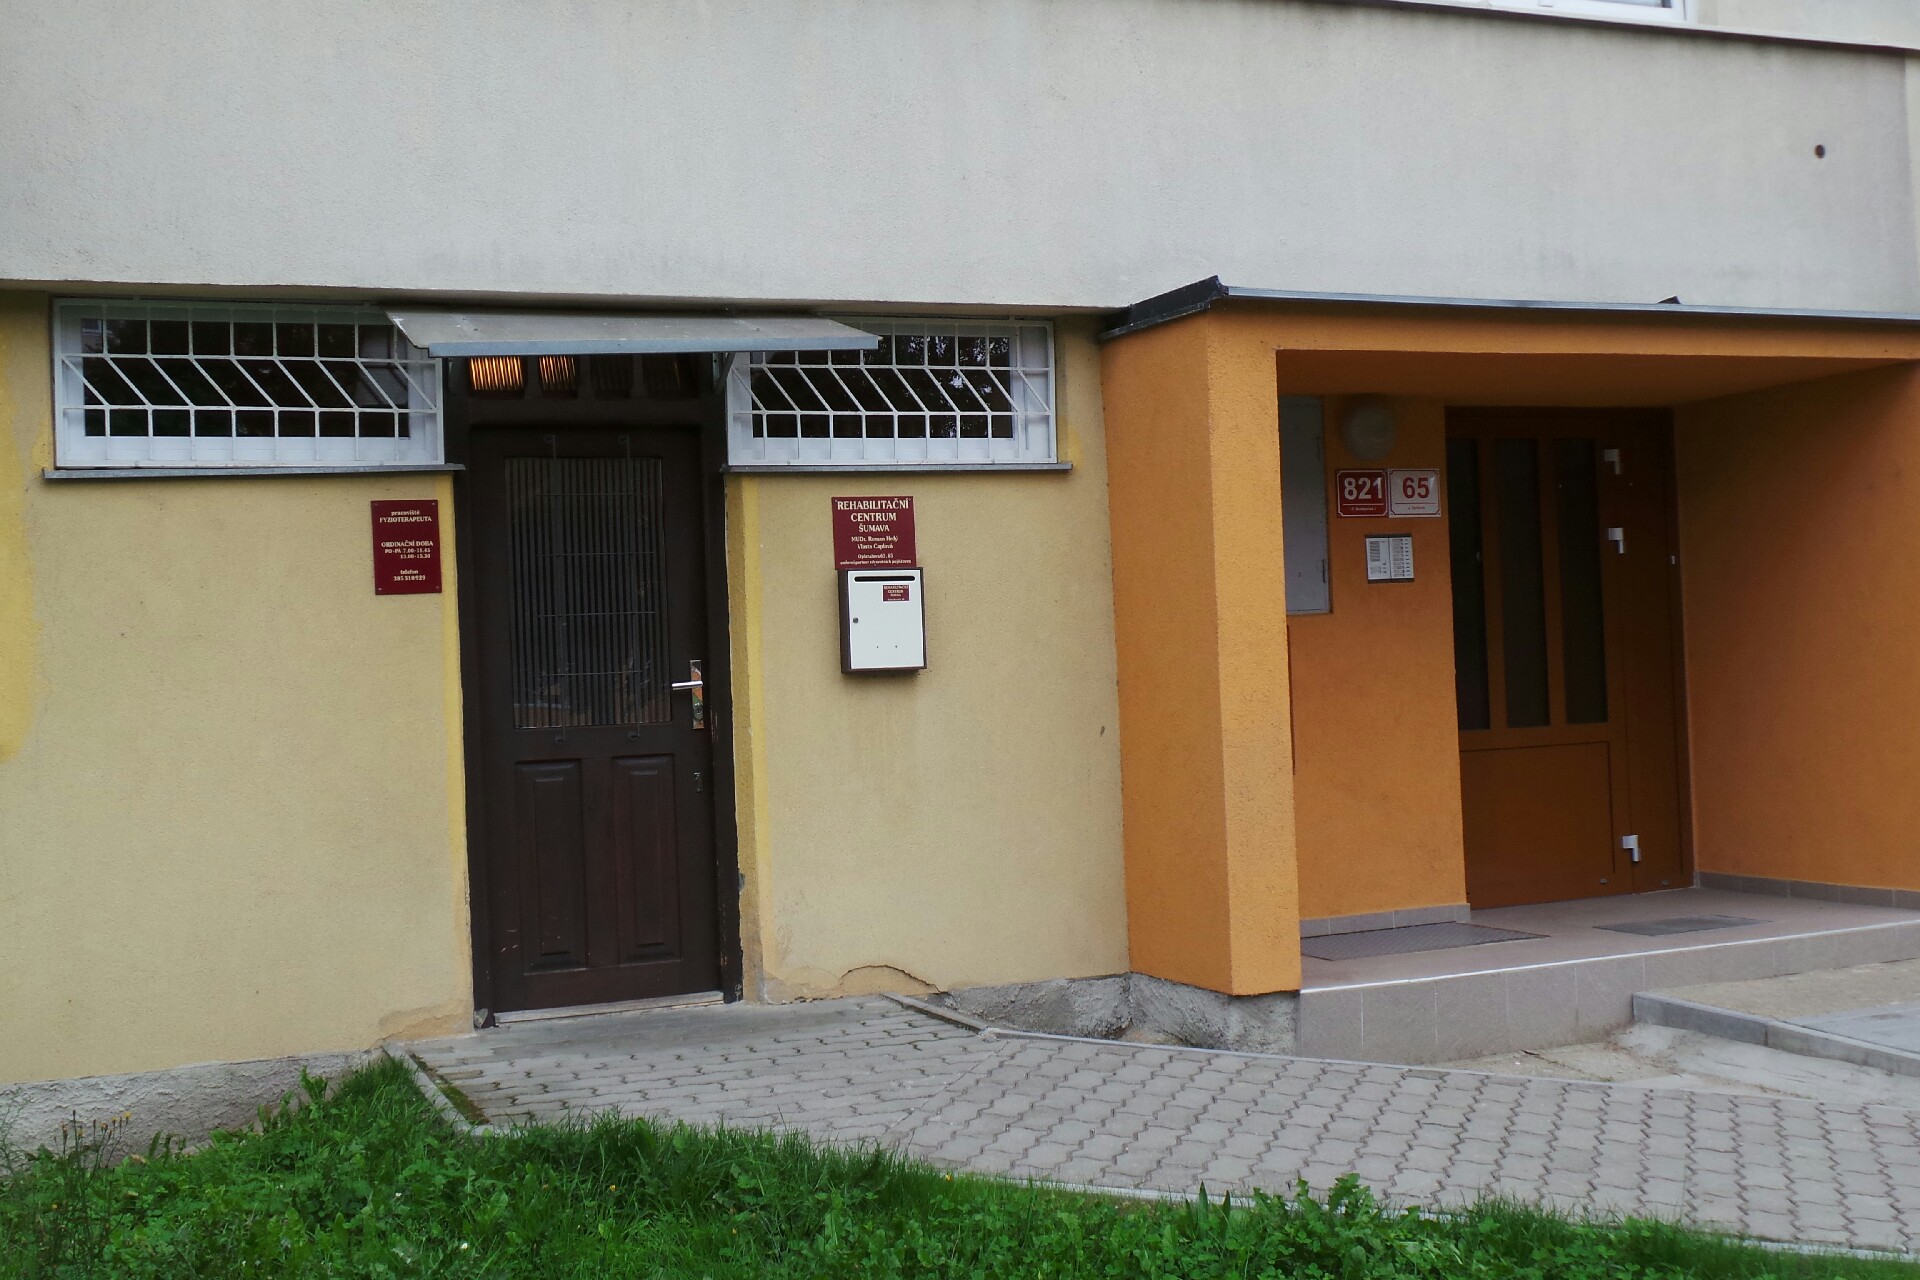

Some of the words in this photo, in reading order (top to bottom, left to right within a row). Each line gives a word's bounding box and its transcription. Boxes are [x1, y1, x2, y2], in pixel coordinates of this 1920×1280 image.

[1344, 477, 1382, 500] 821
[1402, 476, 1430, 499] 65
[837, 498, 909, 510] REHABILITAČNÍ
[850, 512, 897, 522] CENTRUM
[858, 523, 890, 533] ŠUMAVA
[381, 540, 415, 548] ORDINAČNÍ
